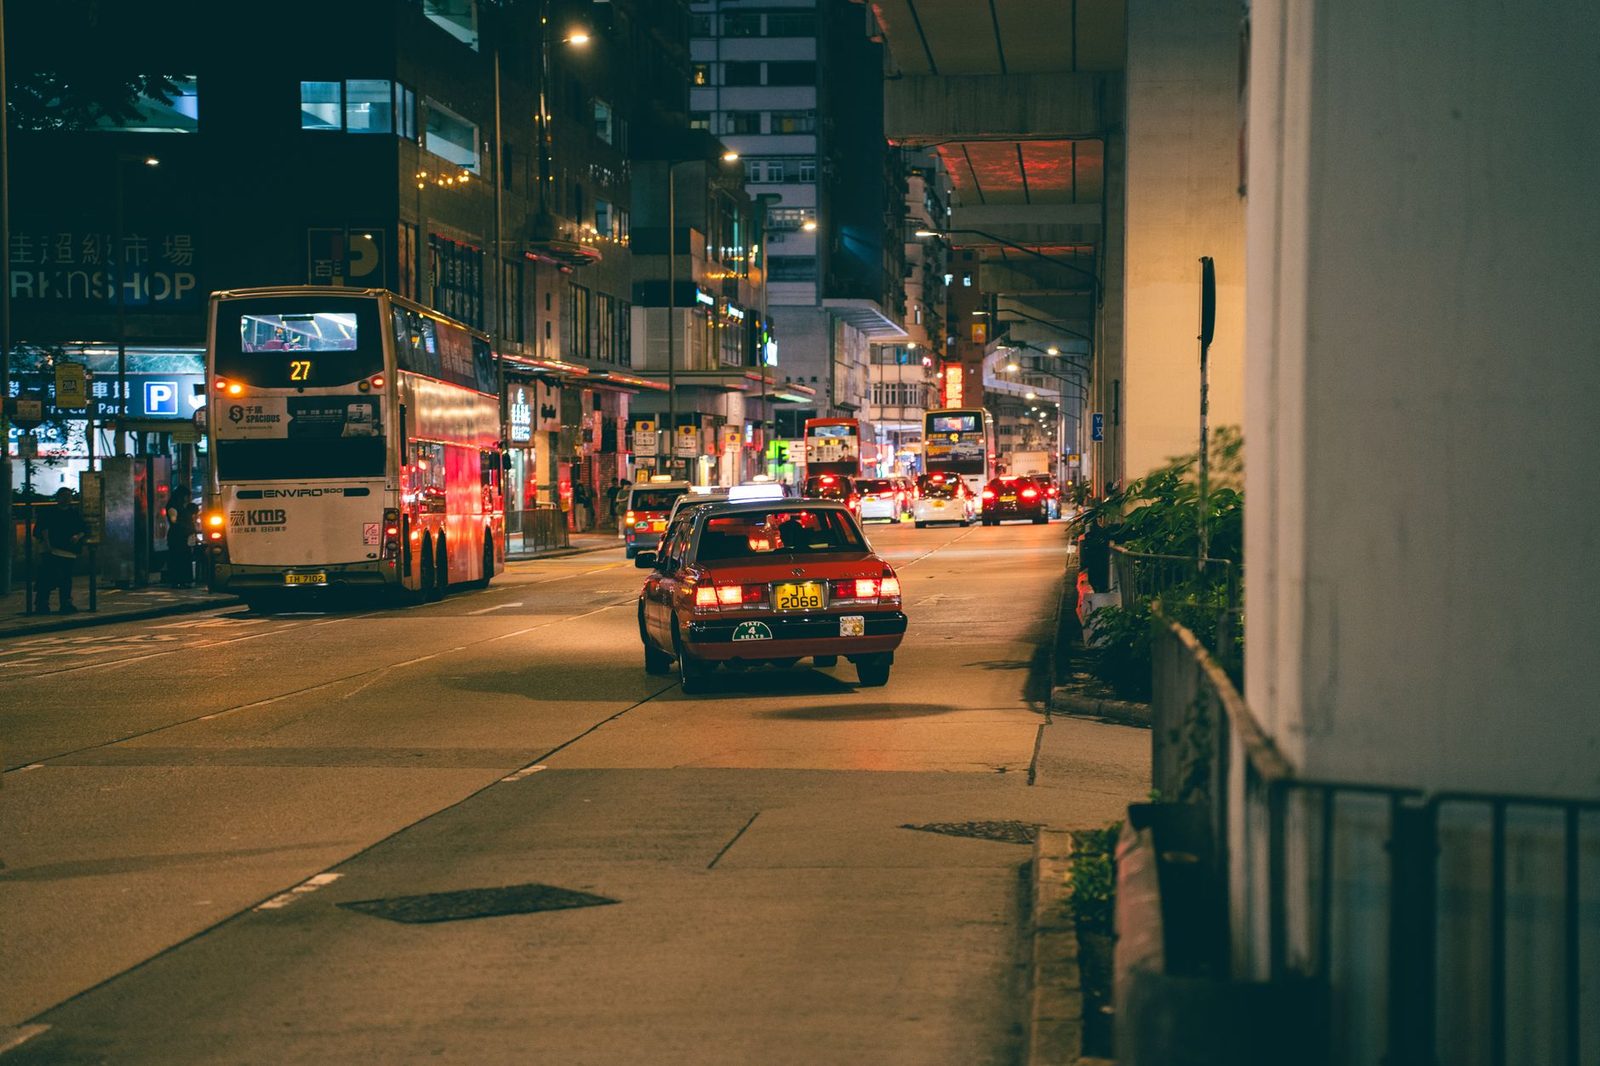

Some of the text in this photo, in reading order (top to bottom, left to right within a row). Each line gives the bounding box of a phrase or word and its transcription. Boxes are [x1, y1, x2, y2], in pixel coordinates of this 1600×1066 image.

[290, 360, 311, 381] 27
[150, 385, 172, 411] P
[246, 414, 281, 423] SPACIOUS
[288, 575, 324, 583] TH 7102
[789, 585, 807, 597] JT
[781, 596, 819, 609] 2068
